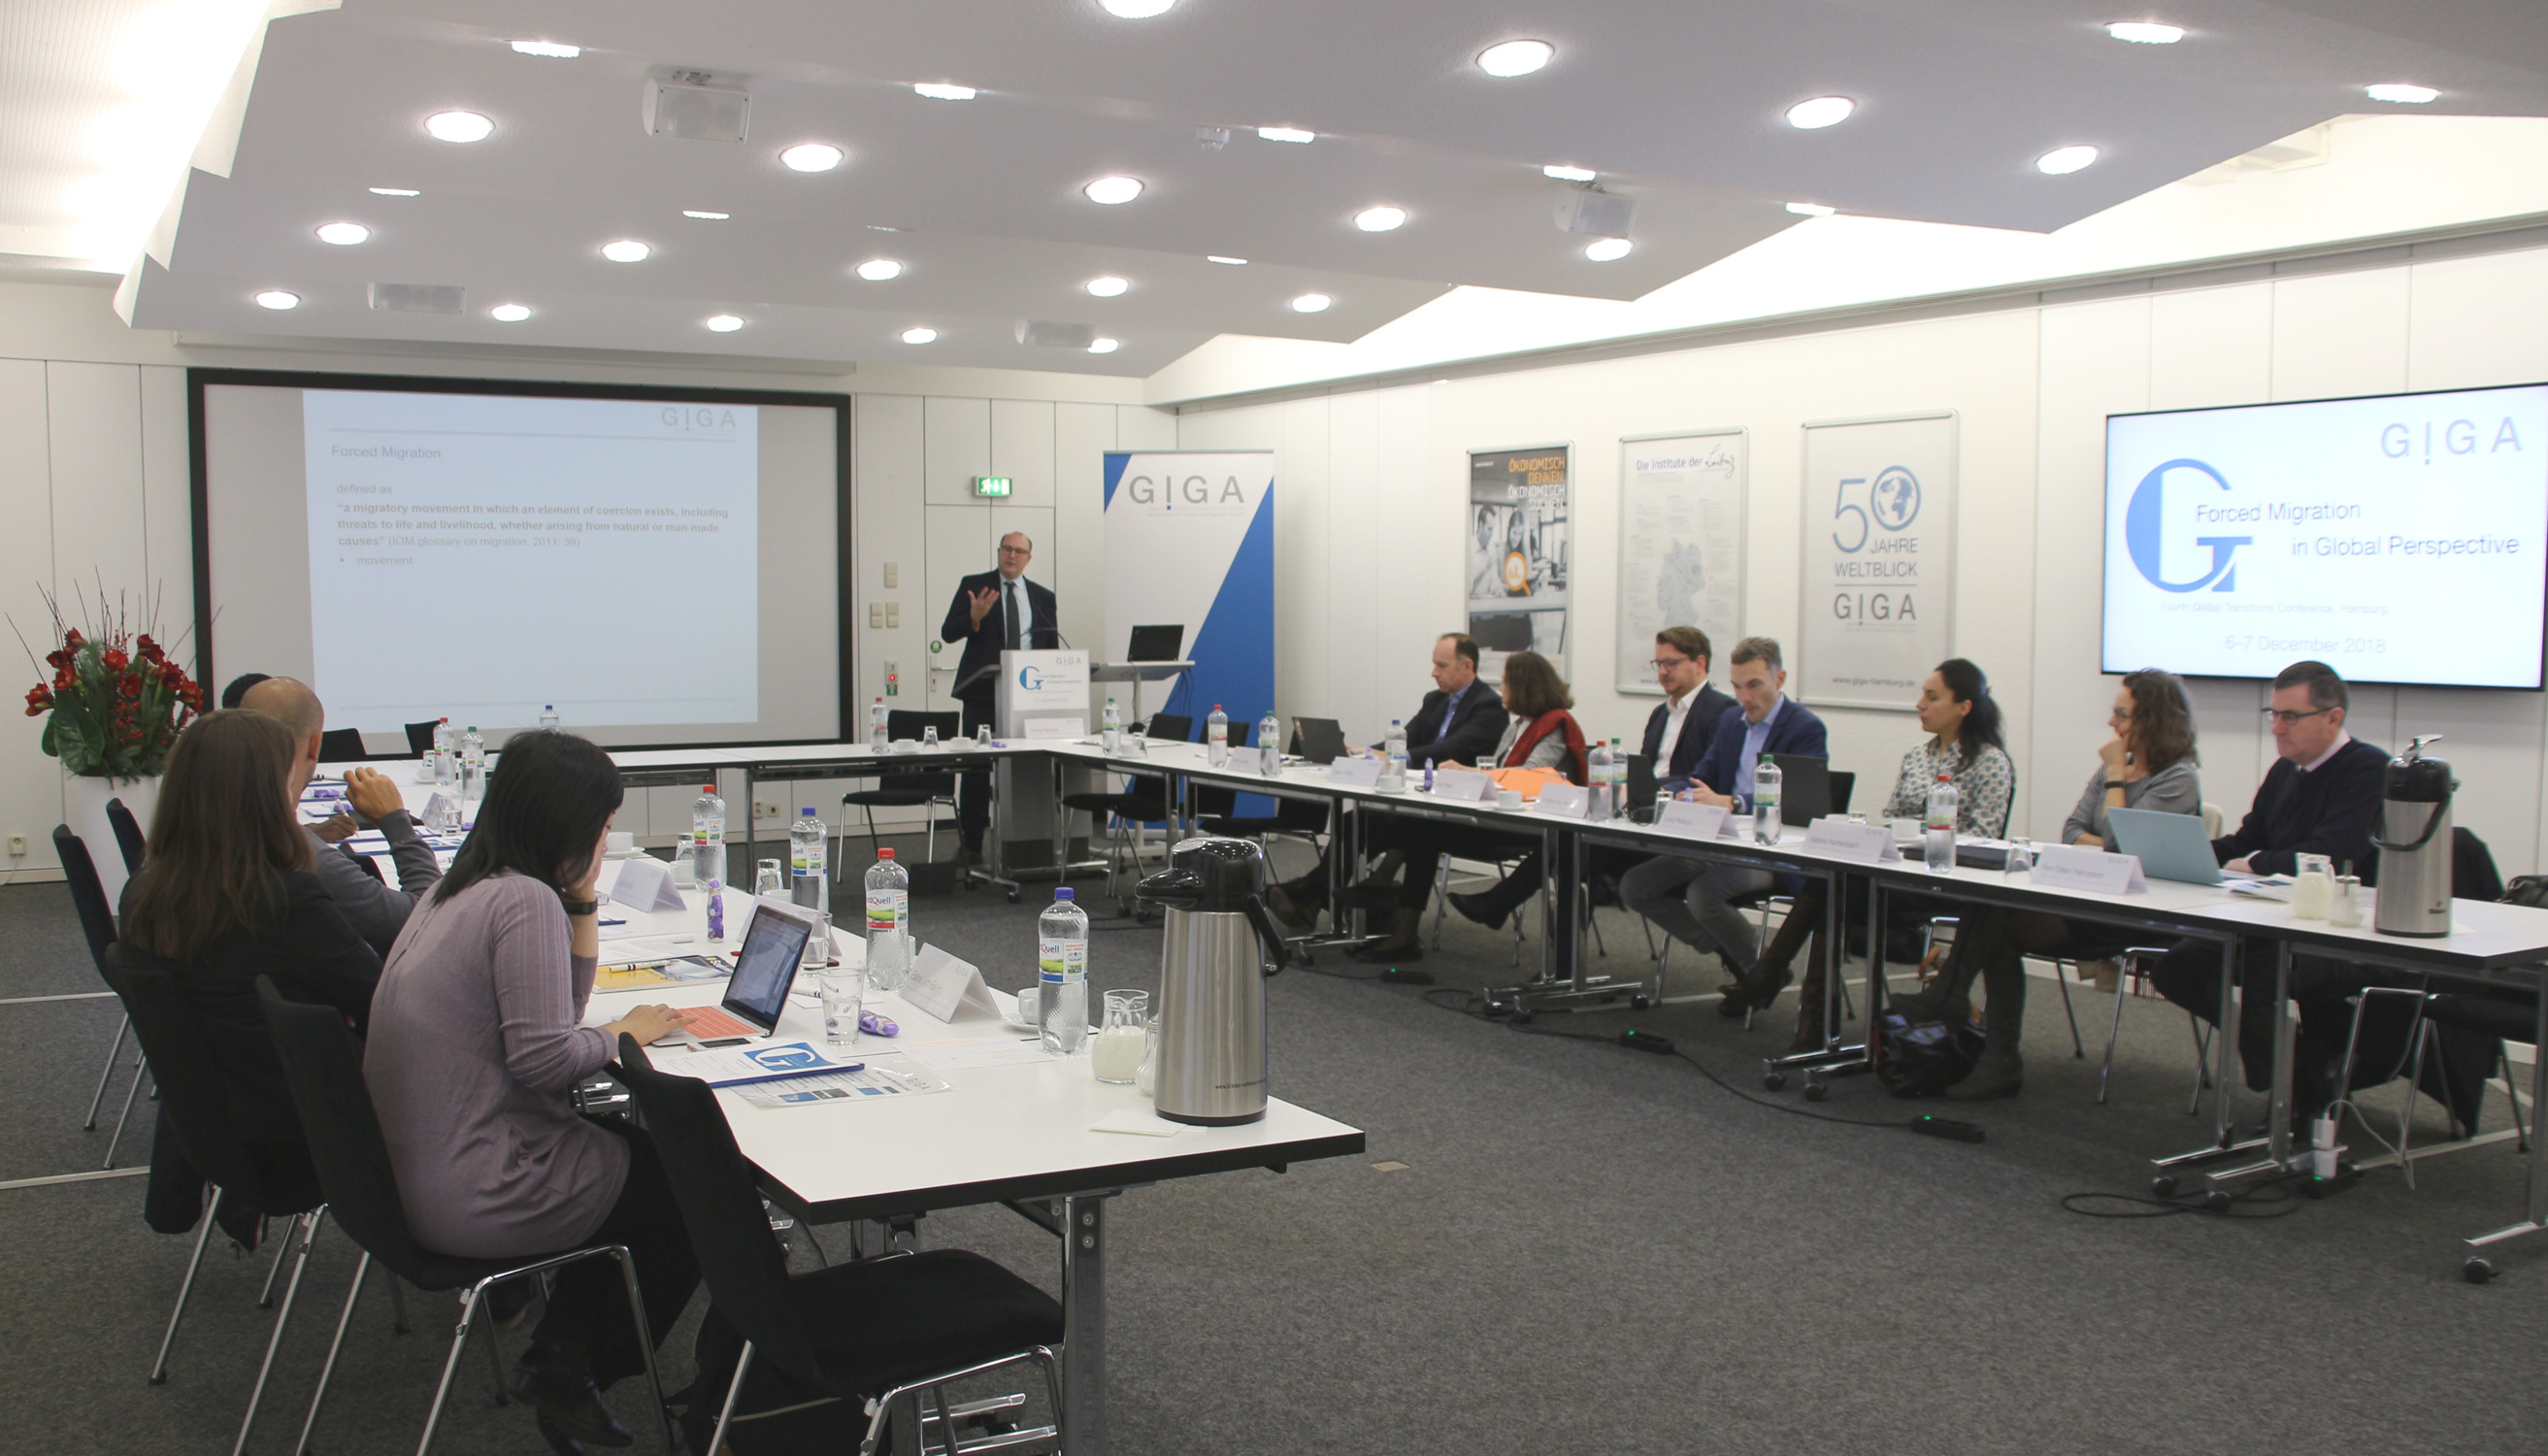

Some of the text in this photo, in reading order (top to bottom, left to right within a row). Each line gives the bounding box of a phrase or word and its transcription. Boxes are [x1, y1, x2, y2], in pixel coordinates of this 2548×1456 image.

[331, 446, 442, 460] Forced Migration
[1508, 456, 1566, 473] ÖKONOMISCH
[1637, 459, 1649, 471] Die
[1652, 457, 1686, 470] Institute
[1689, 456, 1703, 467] der
[336, 484, 376, 493] defined
[1507, 483, 1566, 499] ÖKONOMISCH
[353, 504, 408, 514] migratory
[485, 505, 518, 513] which
[538, 506, 579, 514] element
[583, 506, 593, 514] of
[596, 507, 642, 515] coercion
[645, 507, 678, 517] exists,
[681, 508, 729, 518] including
[2196, 500, 2362, 525] Forced Migration
[338, 520, 378, 529] threats
[381, 520, 392, 529] to
[395, 520, 413, 529] life
[416, 520, 437, 529] and
[440, 520, 497, 531] livelihood,
[500, 521, 543, 530] whether
[546, 522, 582, 533] arising
[585, 522, 610, 532] from
[612, 522, 649, 532] natural
[666, 523, 719, 533] man-made
[388, 537, 414, 546] (IOM
[417, 537, 461, 547] glossary
[533, 538, 561, 546] 2011:
[564, 538, 580, 547] 39)
[1870, 537, 1919, 554] JAHRE
[2292, 533, 2521, 560] in Global Perspective
[1835, 561, 1918, 579] WELTBLICK
[2161, 601, 2191, 612] Fourth
[2193, 601, 2223, 612] Global
[2224, 601, 2275, 613] Transitions
[2340, 603, 2389, 615] Hamburg
[2259, 636, 2338, 652] December
[2344, 638, 2387, 653] 2018
[1833, 675, 1917, 688] www.giga-hamburg.de
